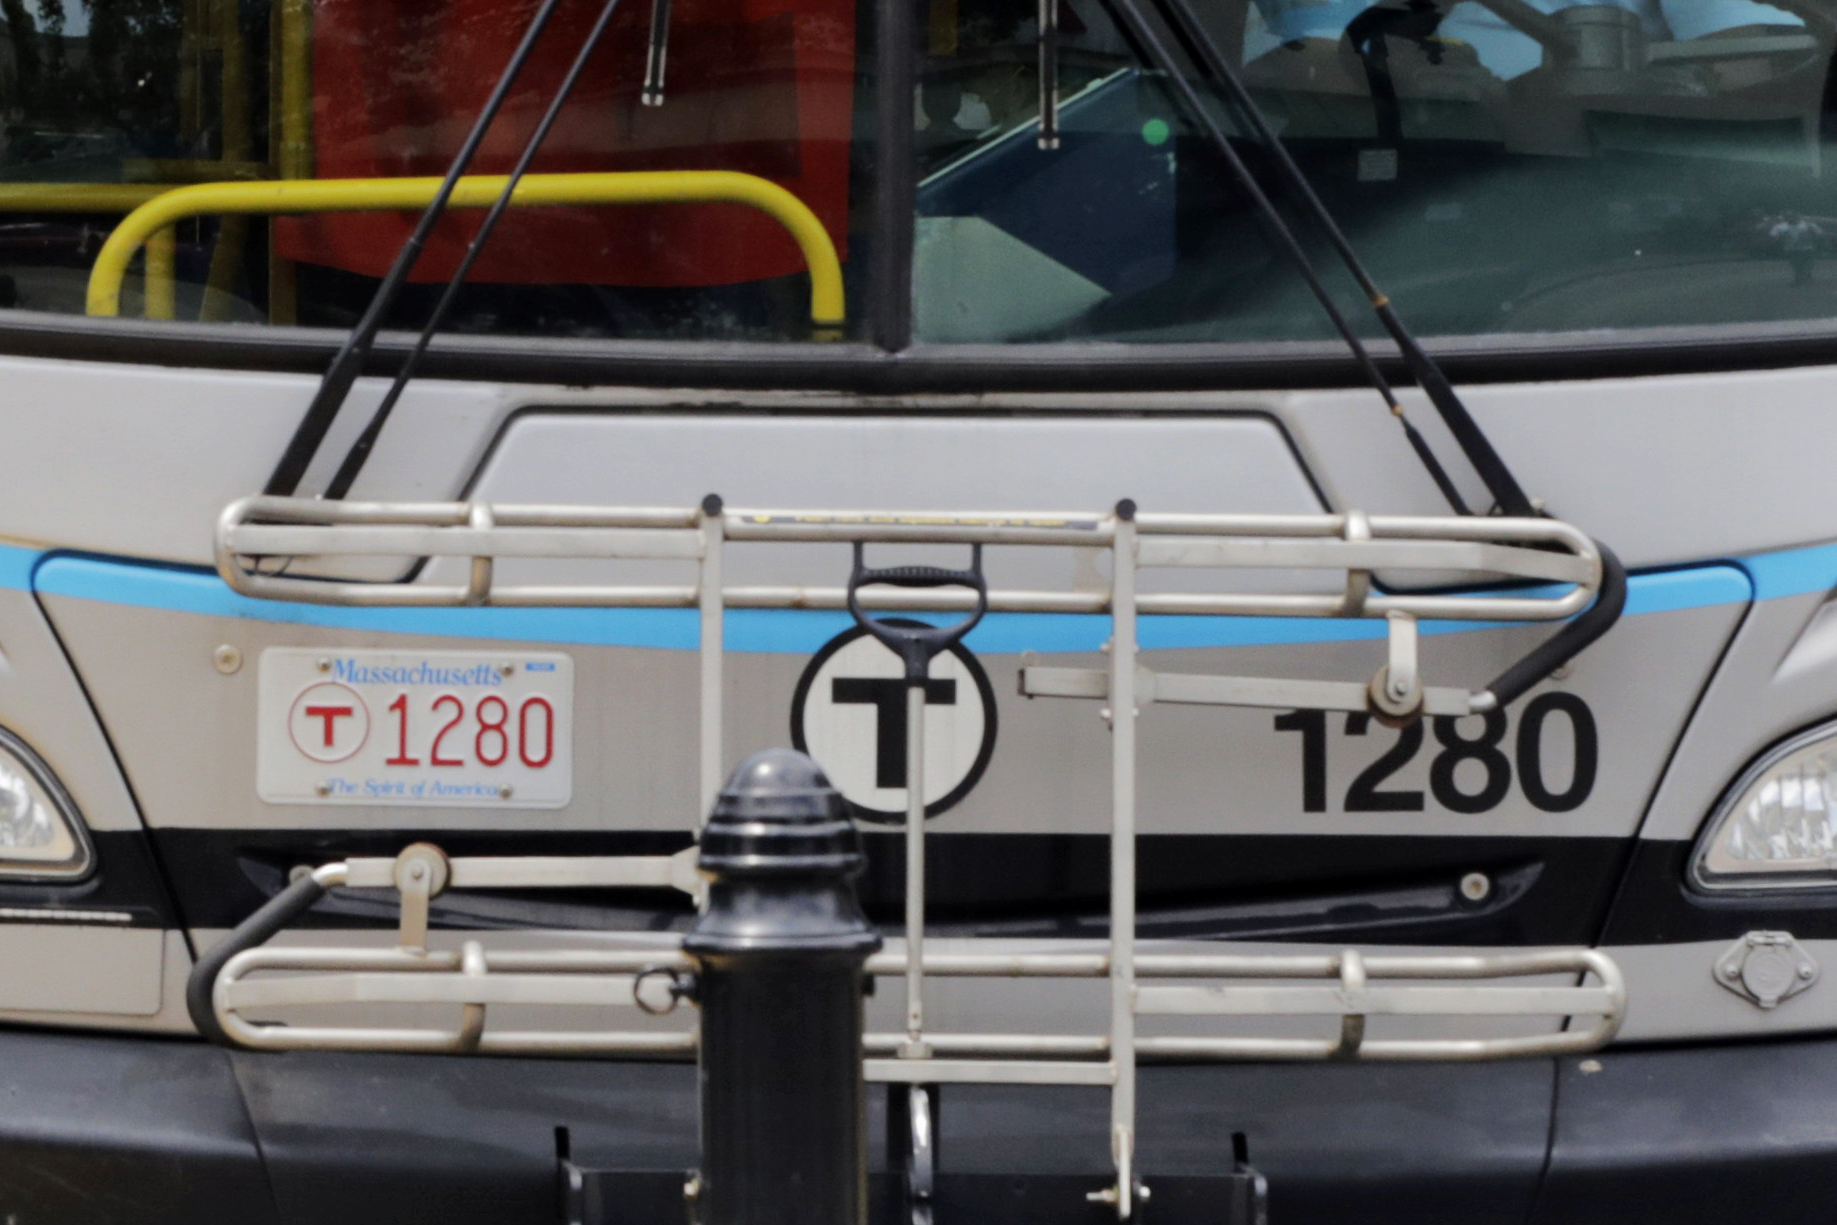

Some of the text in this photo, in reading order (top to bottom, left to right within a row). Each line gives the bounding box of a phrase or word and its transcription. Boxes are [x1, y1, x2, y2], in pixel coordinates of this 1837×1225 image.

[331, 658, 504, 687] Massachusetts
[385, 693, 554, 768] 1280
[1274, 690, 1598, 814] 1280
[329, 778, 358, 794] The
[364, 779, 406, 798] Spirit
[410, 781, 428, 799] of
